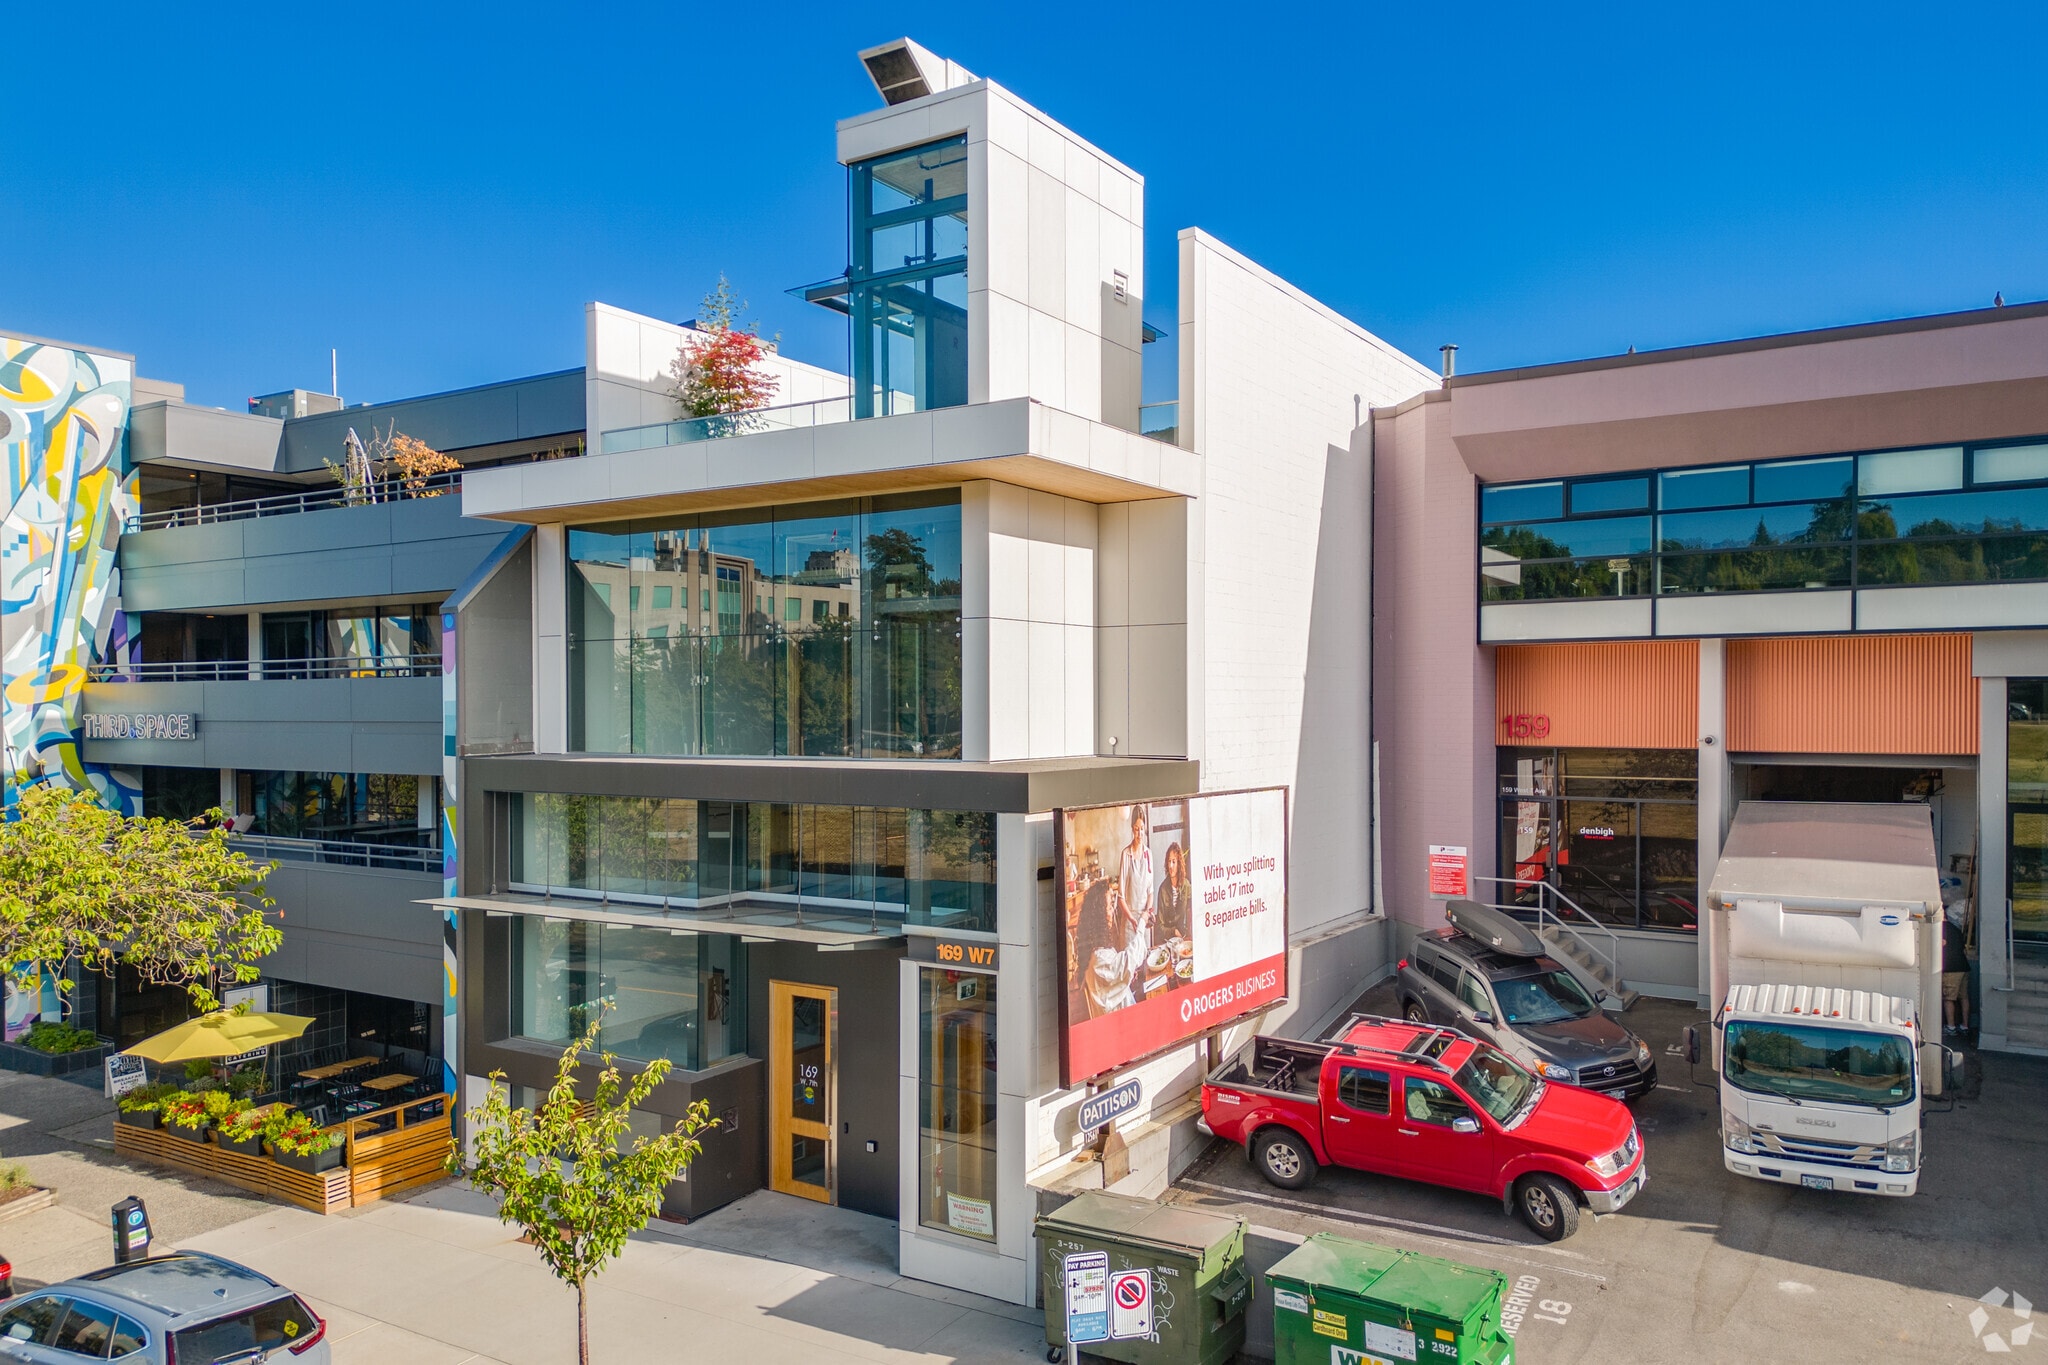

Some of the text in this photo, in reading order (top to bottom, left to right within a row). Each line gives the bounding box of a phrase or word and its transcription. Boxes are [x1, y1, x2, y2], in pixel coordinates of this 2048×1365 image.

[82, 713, 190, 739] THIRD SPACE
[1503, 714, 1550, 738] 159
[1519, 826, 1534, 834] 159
[1580, 826, 1614, 837] denbigh
[1203, 854, 1275, 881] With you splitting
[1204, 881, 1254, 904] table 17 into
[1204, 897, 1268, 928] 8 separate bills.
[936, 944, 995, 965] 169 W7
[1194, 969, 1276, 1016] ROGERS BUSINESS
[227, 1049, 266, 1062] CATERING
[800, 1063, 818, 1079] 169
[1083, 1085, 1138, 1126] PATTISON
[1796, 1116, 1836, 1128] ISUZU
[952, 1202, 984, 1214] WARNING
[1058, 1240, 1084, 1251] 3-257
[1068, 1260, 1105, 1270] PAY PARKING
[1157, 1265, 1180, 1277] WASTE
[1533, 1299, 1572, 1326] 18
[1418, 1338, 1458, 1357] 3 2922
